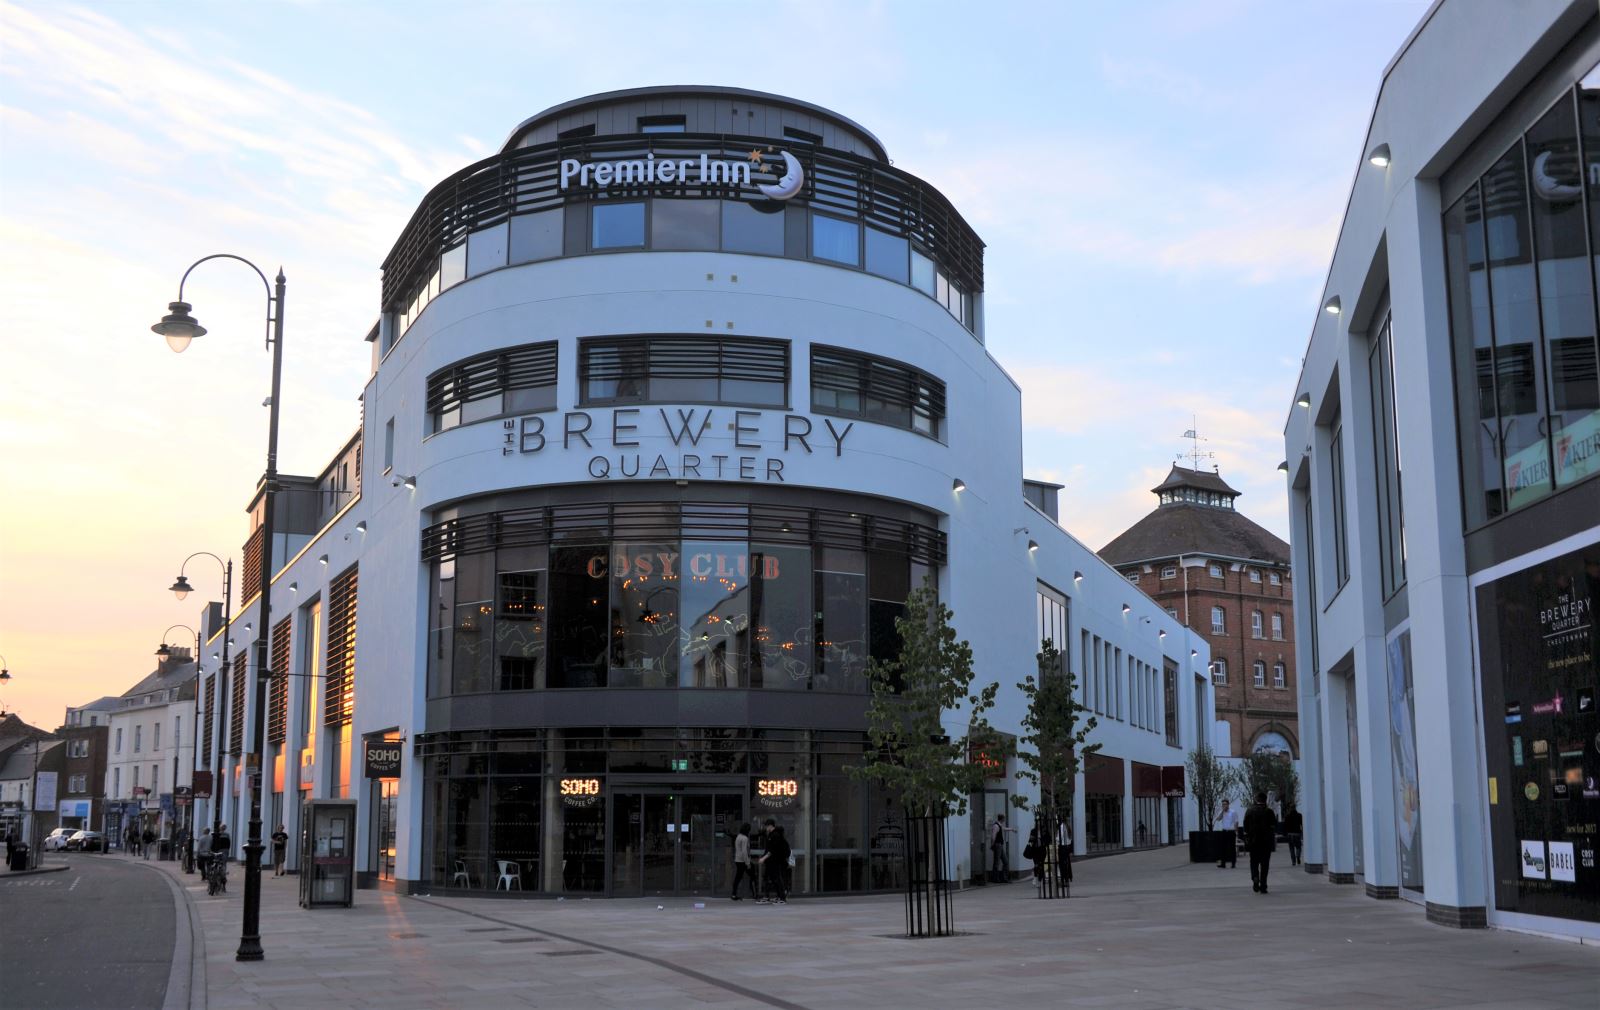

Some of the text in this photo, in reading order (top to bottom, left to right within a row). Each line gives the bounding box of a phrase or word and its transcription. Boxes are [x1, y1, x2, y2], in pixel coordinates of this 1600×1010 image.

[560, 152, 750, 189] Premier Inn
[503, 408, 854, 457] THE BREWERY
[588, 453, 785, 482] QUARTER
[1522, 459, 1549, 489] KIER
[586, 552, 780, 580] COSY CLUB
[1558, 594, 1569, 603] THE
[1540, 597, 1591, 624] BREWERY
[1551, 616, 1580, 631] QUARTER
[368, 749, 400, 761] SOHO
[560, 779, 599, 795] SOHO
[758, 779, 798, 796] SOHO
[1165, 789, 1183, 797] wilko
[564, 796, 586, 807] COFFEE
[760, 797, 783, 808] COFFEE
[1550, 852, 1574, 870] BABEL
[1581, 849, 1594, 858] COSY
[1582, 858, 1595, 868] CLUB
